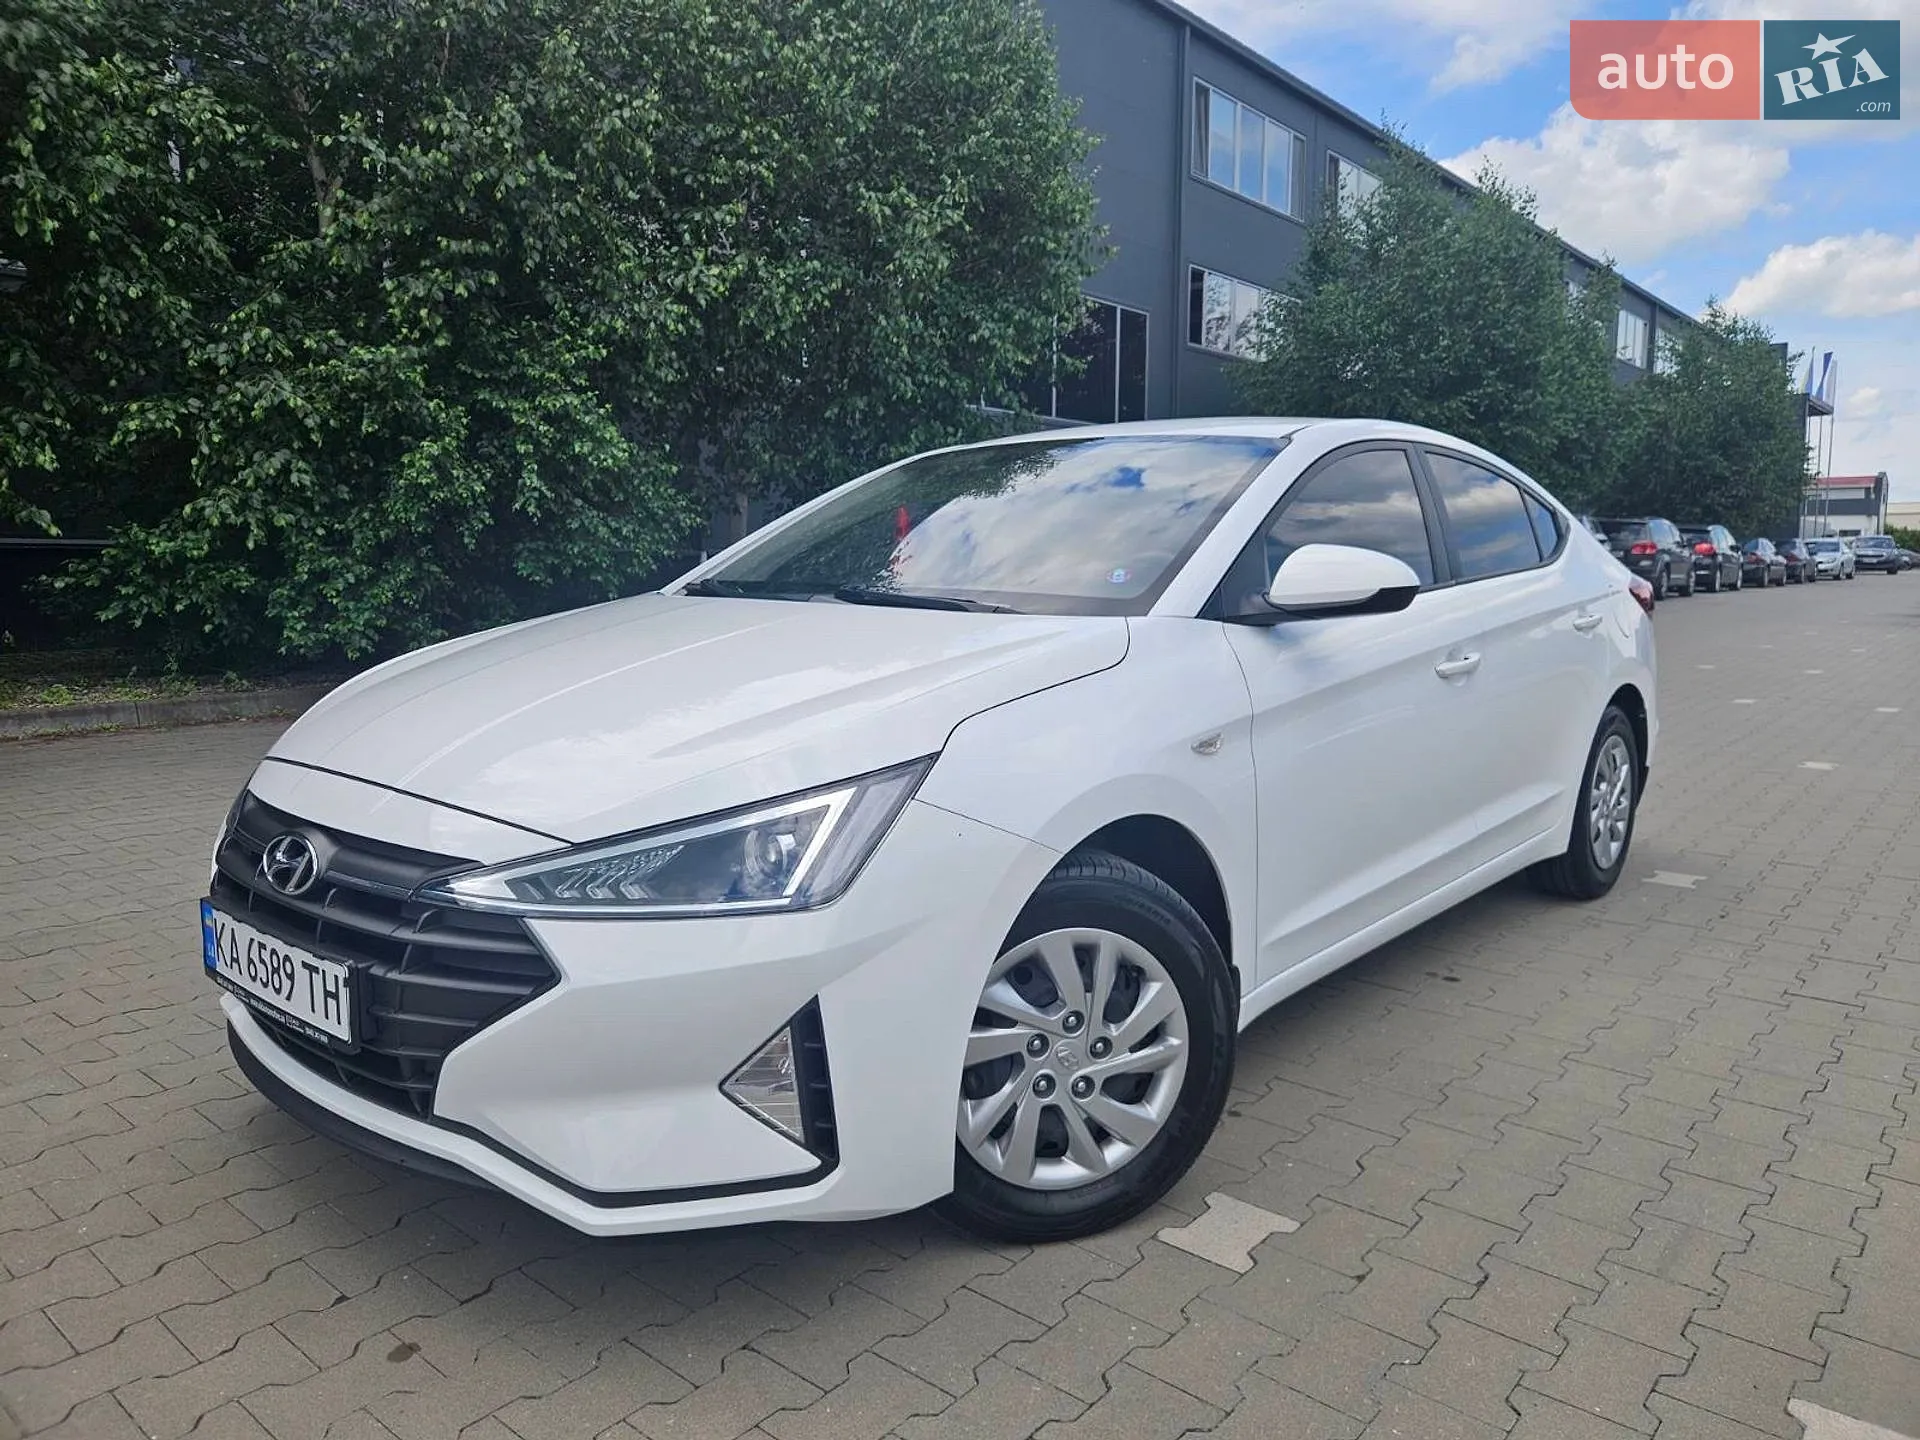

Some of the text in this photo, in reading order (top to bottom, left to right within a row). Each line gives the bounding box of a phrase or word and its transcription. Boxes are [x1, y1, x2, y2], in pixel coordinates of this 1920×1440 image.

[214, 918, 243, 976] KA
[247, 938, 295, 1002] 6589
[302, 960, 342, 1025] TH
